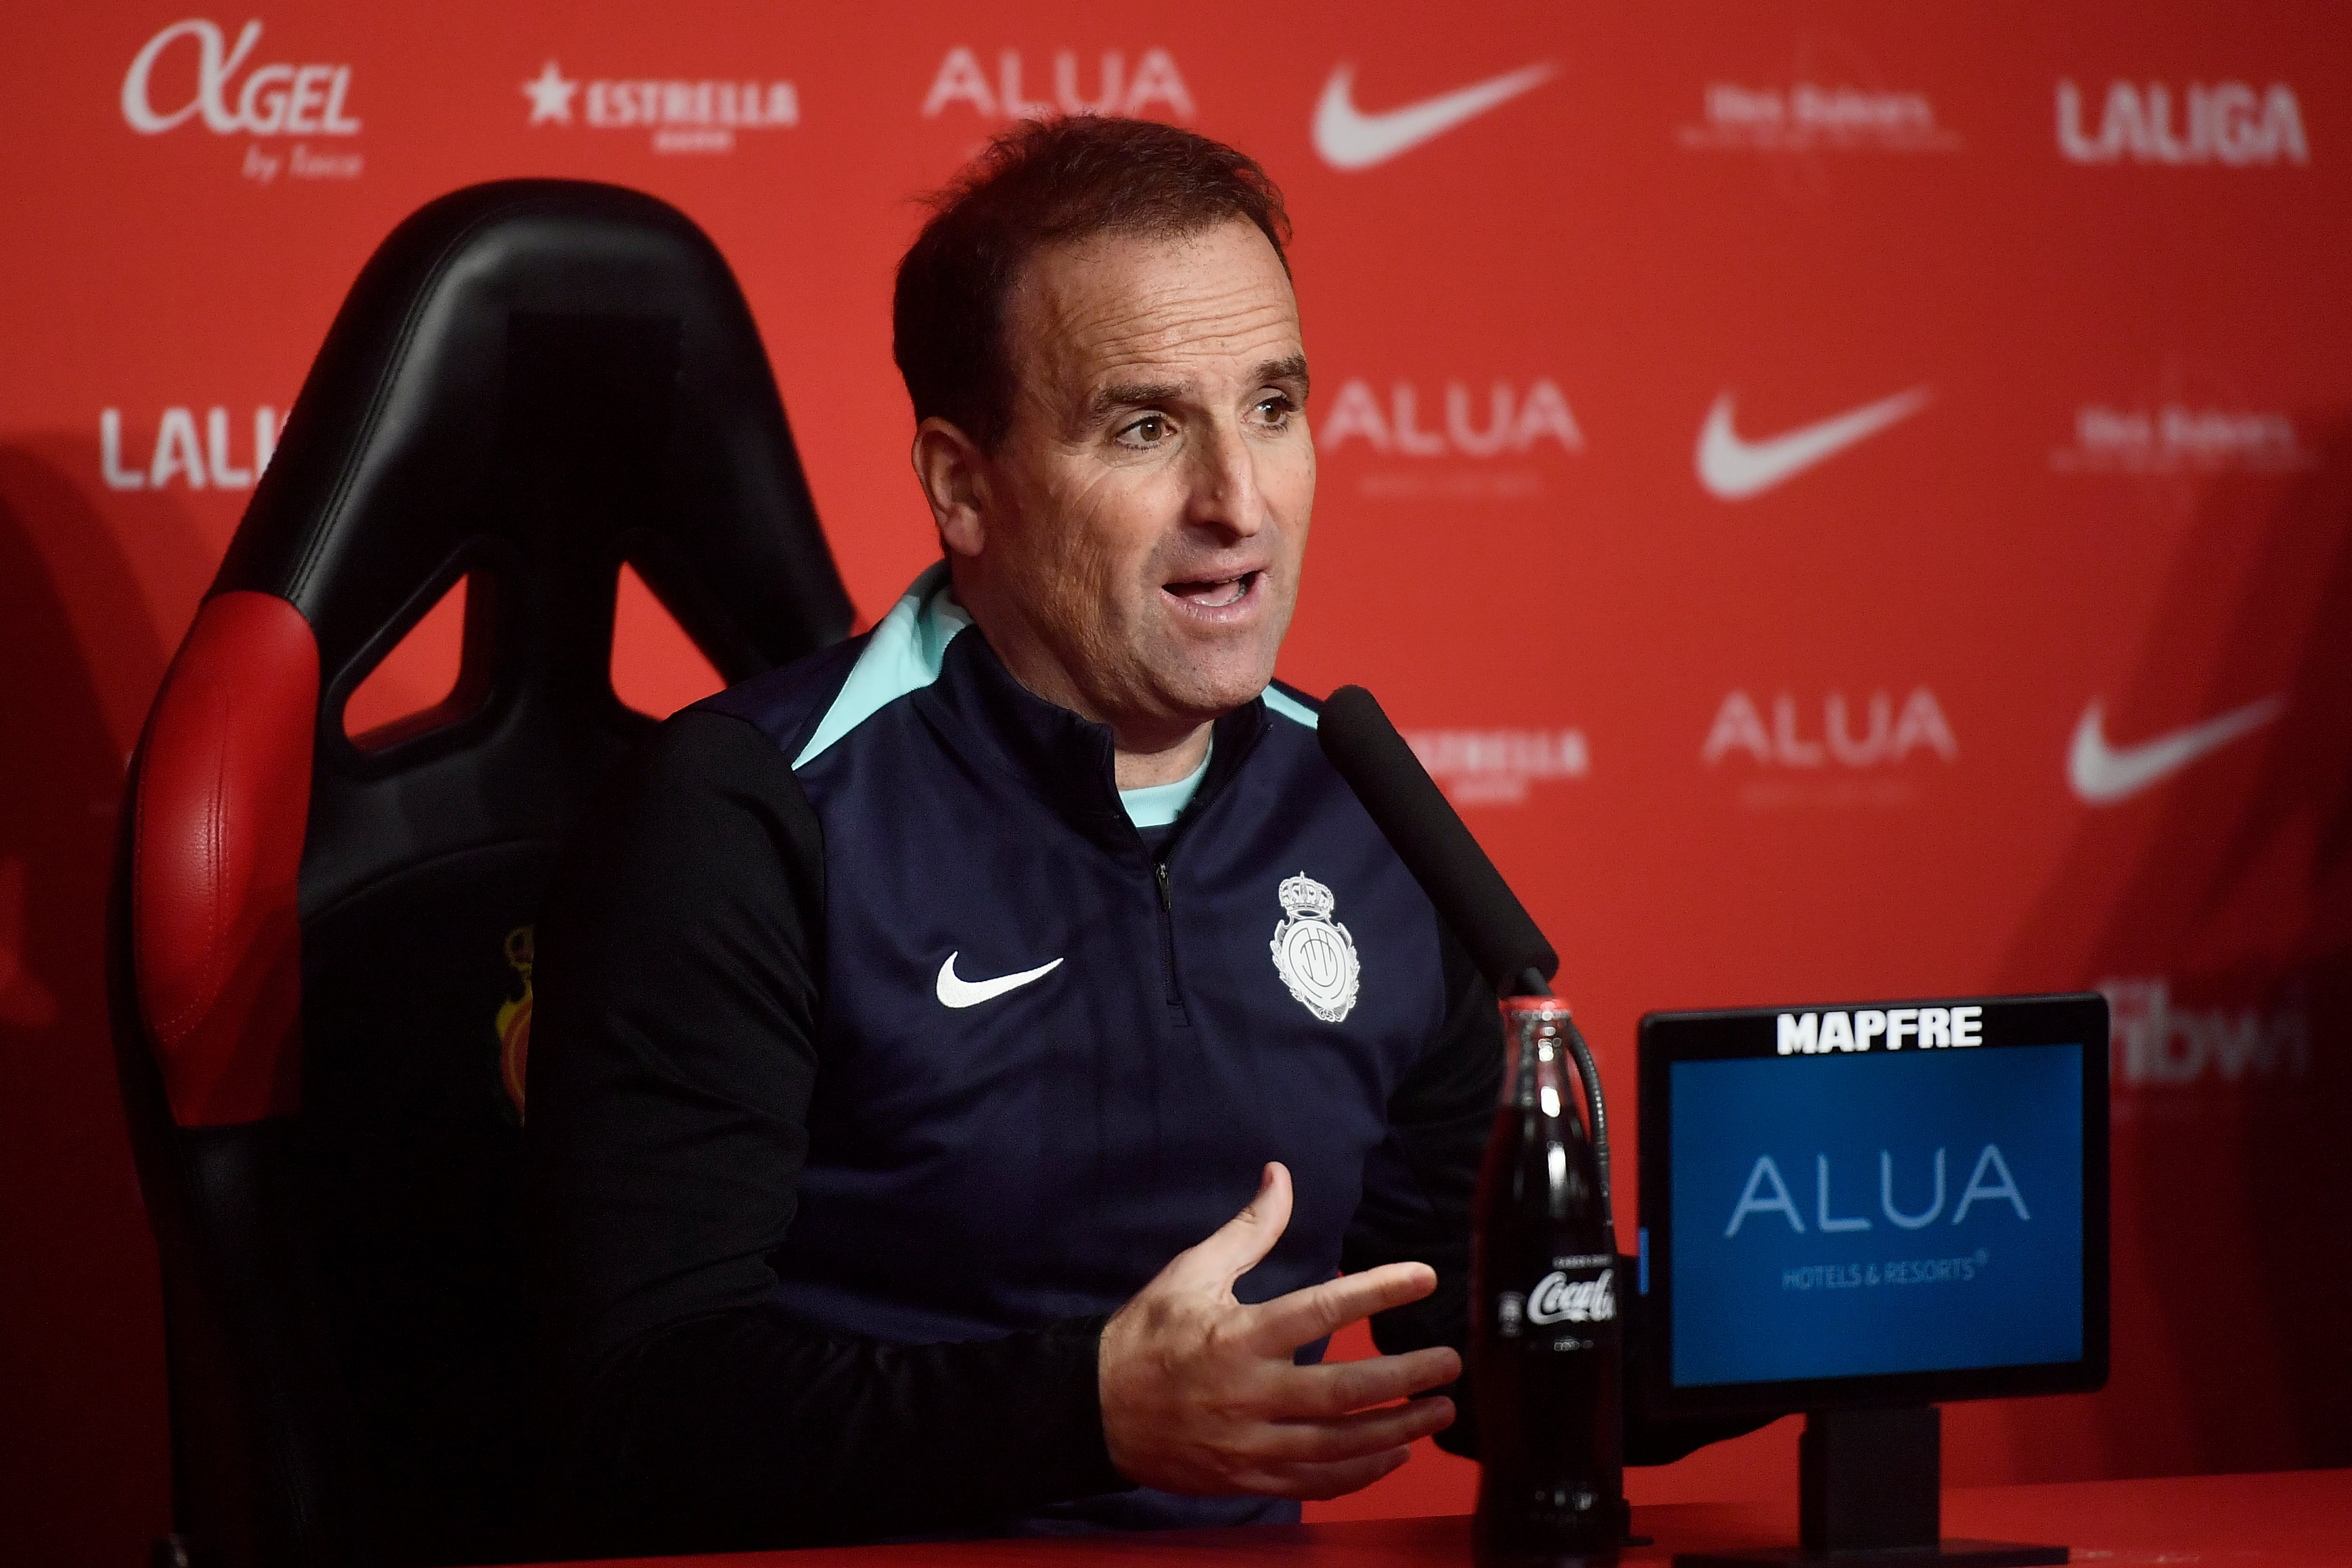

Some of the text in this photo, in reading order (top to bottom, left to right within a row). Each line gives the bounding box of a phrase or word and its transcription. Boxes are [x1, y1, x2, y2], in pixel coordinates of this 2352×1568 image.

[585, 79, 799, 127] ESTRELLA
[921, 43, 1199, 121] ALUA
[2056, 79, 2310, 165] LALIGA
[100, 405, 291, 492] LALI
[1317, 376, 1587, 457] ALUA
[1699, 685, 1960, 767] ALUA
[1776, 1005, 1983, 1055] MAPFRE
[1723, 1142, 2031, 1239] ALUA
[1782, 1264, 1863, 1290] HOTELS
[1864, 1263, 1881, 1287] &
